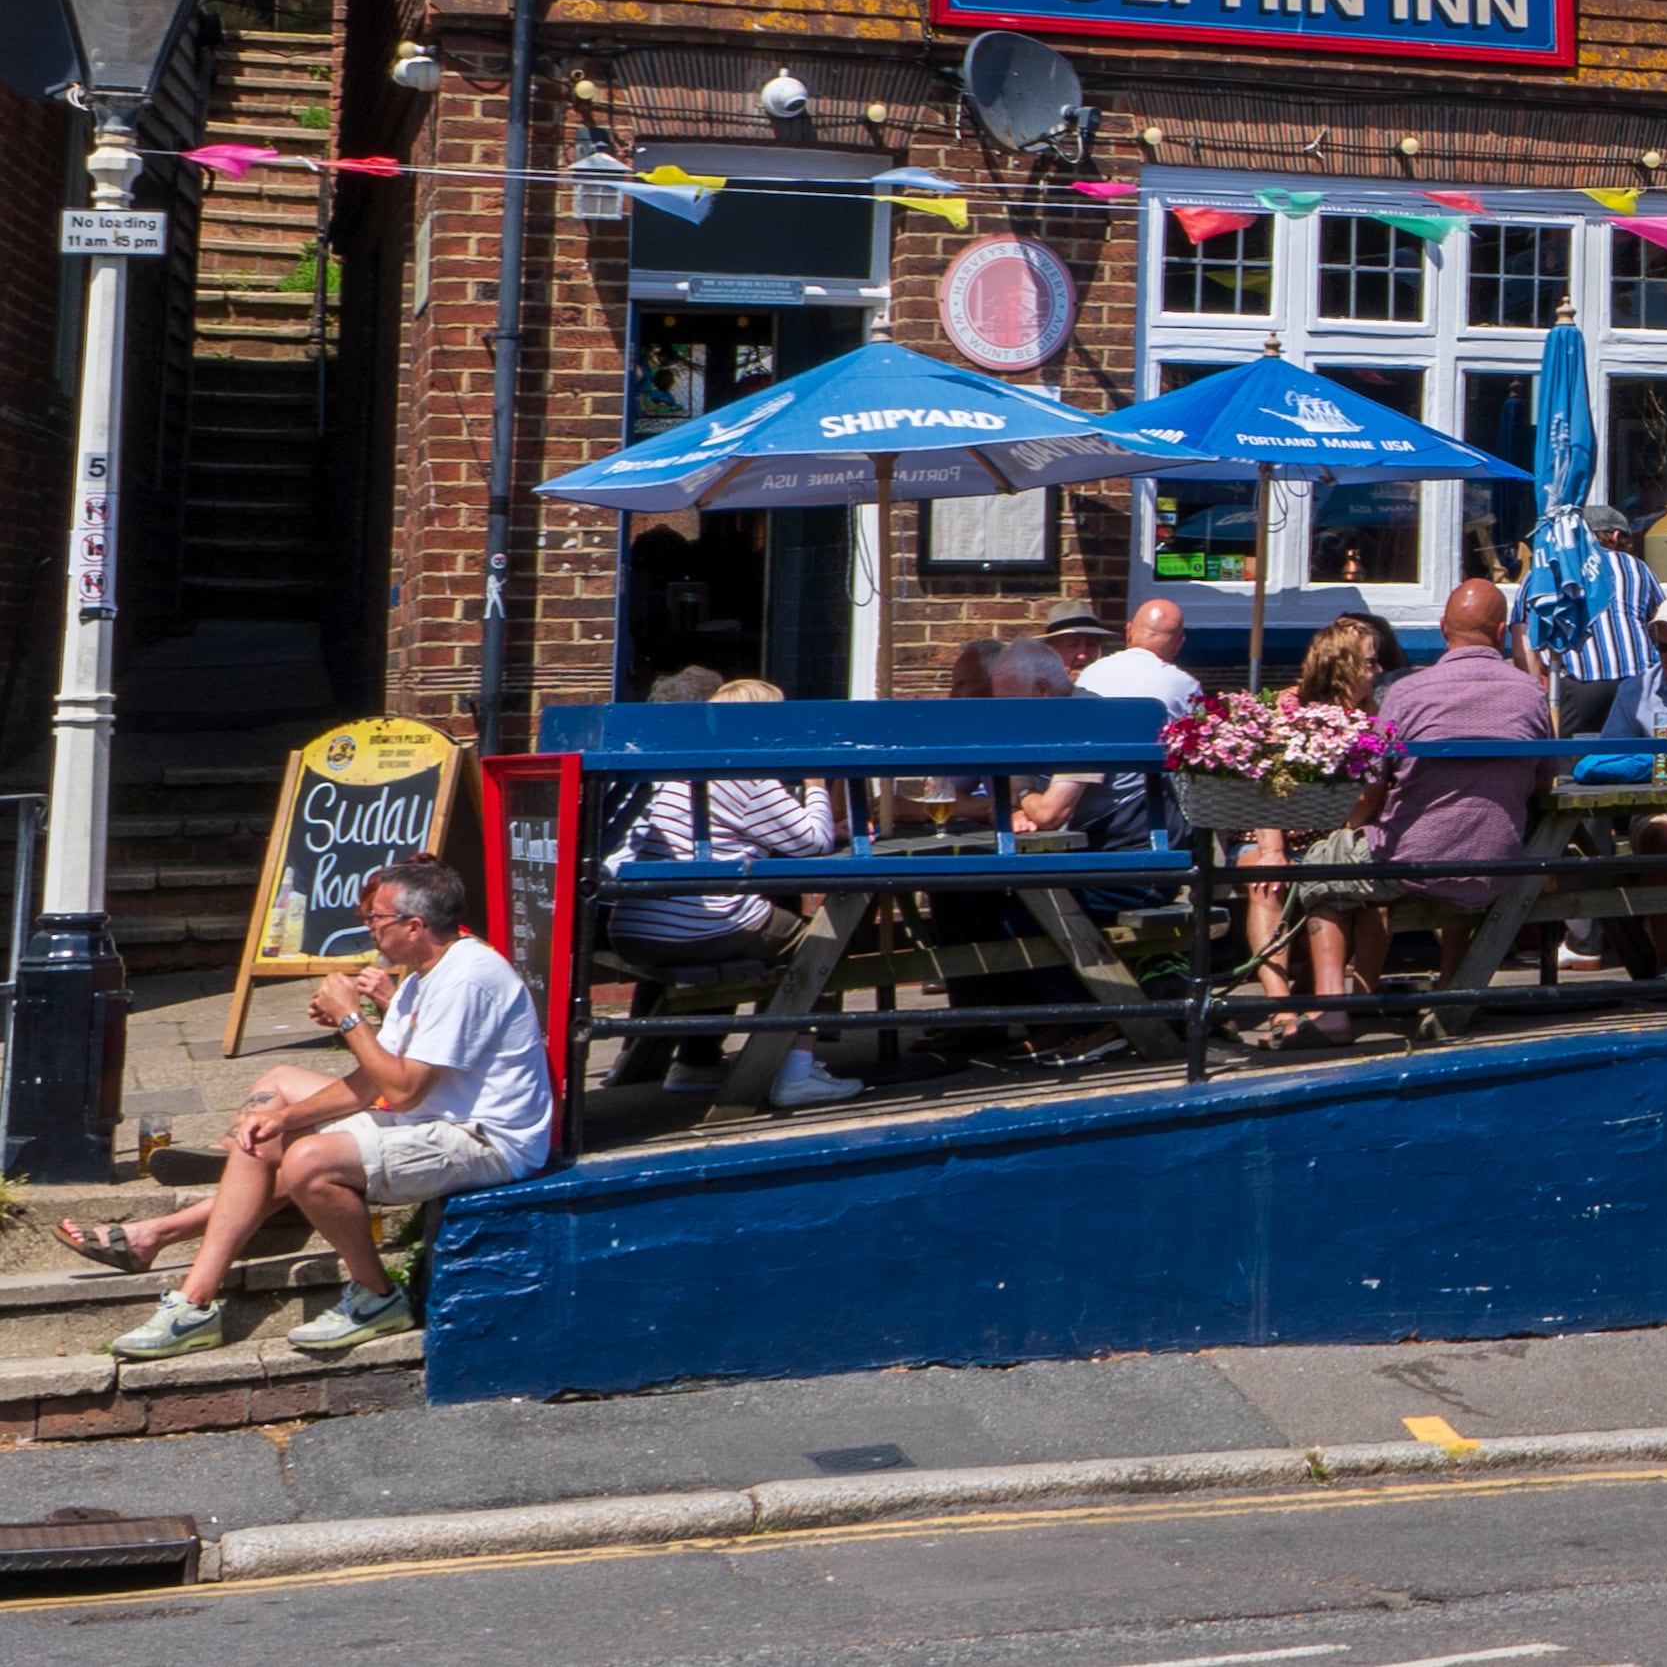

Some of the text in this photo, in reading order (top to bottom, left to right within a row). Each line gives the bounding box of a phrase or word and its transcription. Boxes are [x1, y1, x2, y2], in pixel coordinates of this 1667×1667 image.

[72, 217, 156, 231] No loading
[68, 235, 80, 246] 11
[85, 237, 108, 247] am
[134, 238, 158, 249] pm
[1015, 347, 1035, 360] BE
[819, 409, 1006, 438] SHIPYARD
[1236, 433, 1416, 452] PORTLAND MAINE USA
[88, 458, 106, 477] 5
